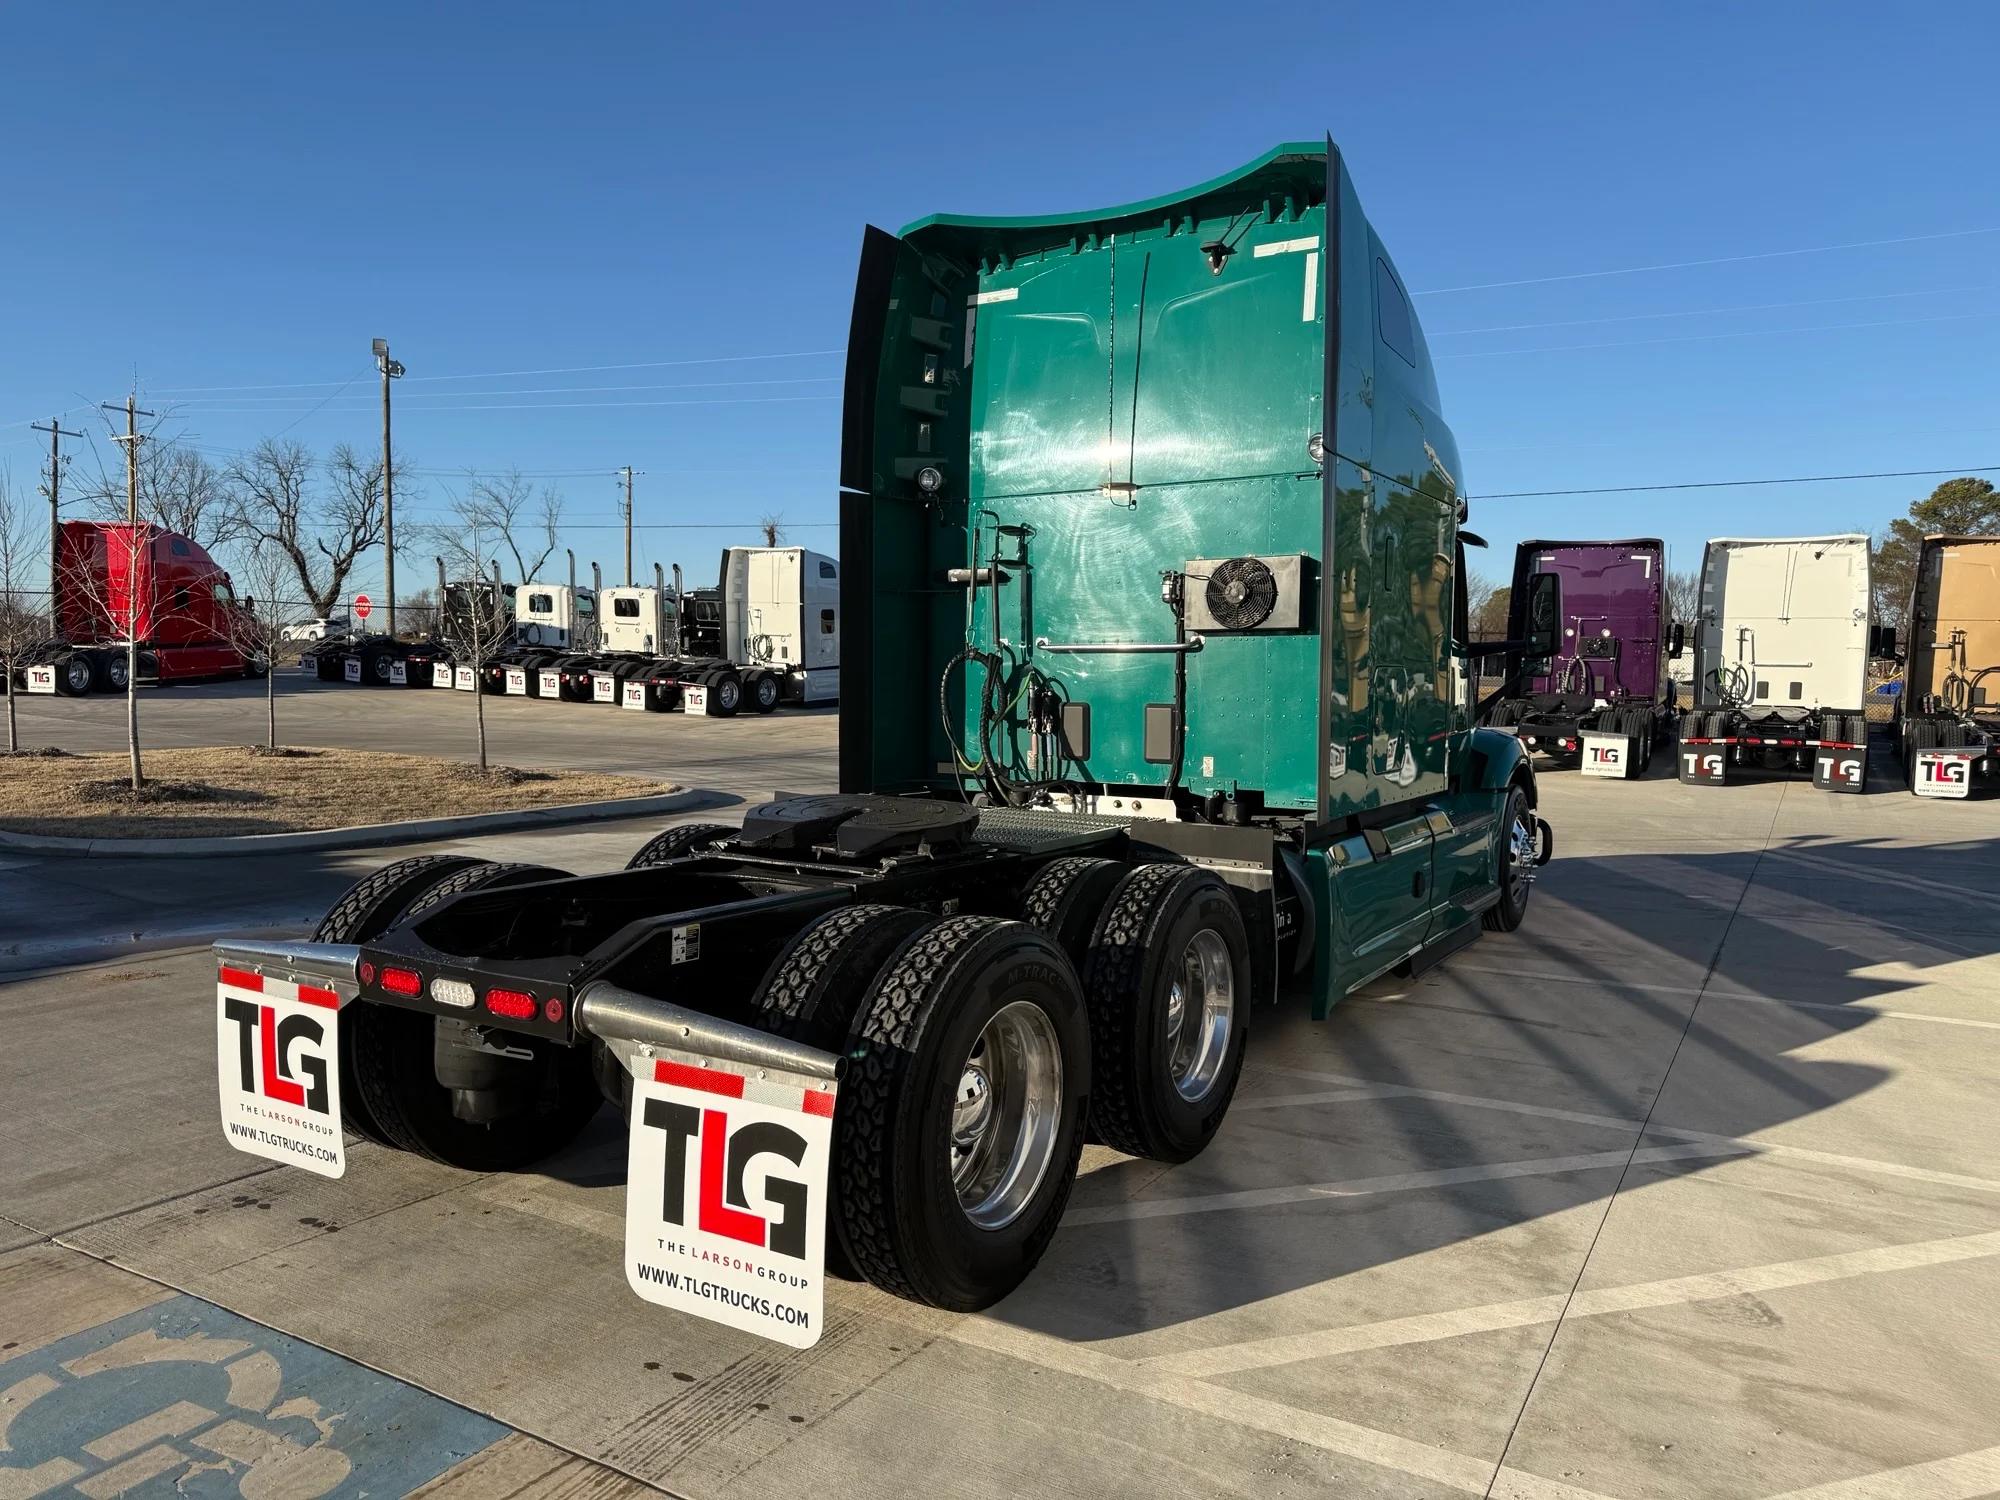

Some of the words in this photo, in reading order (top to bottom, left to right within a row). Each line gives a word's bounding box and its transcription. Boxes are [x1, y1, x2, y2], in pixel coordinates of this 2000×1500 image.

[356, 602, 369, 611] STOP
[32, 671, 50, 683] TLG
[543, 677, 556, 688] TLG
[597, 681, 611, 692] TLG
[627, 689, 641, 700] TLG
[688, 694, 703, 705] TLG
[1590, 747, 1619, 764] TLG
[1683, 753, 1723, 775] TLG
[1818, 757, 1861, 782] TLG
[1920, 761, 1964, 783] TLG
[225, 997, 329, 1115] TLG
[240, 1103, 258, 1115] THE
[262, 1109, 300, 1126] LARSON
[302, 1121, 333, 1136] GROUP
[229, 1122, 338, 1165] WWW.TLGTRUCKS.COM
[643, 1097, 808, 1260] TLG
[658, 1239, 685, 1255] THE
[692, 1247, 753, 1274] LARSON
[757, 1267, 808, 1289] GROUP
[637, 1262, 809, 1329] WWW.TLGTRUCKS.COM
